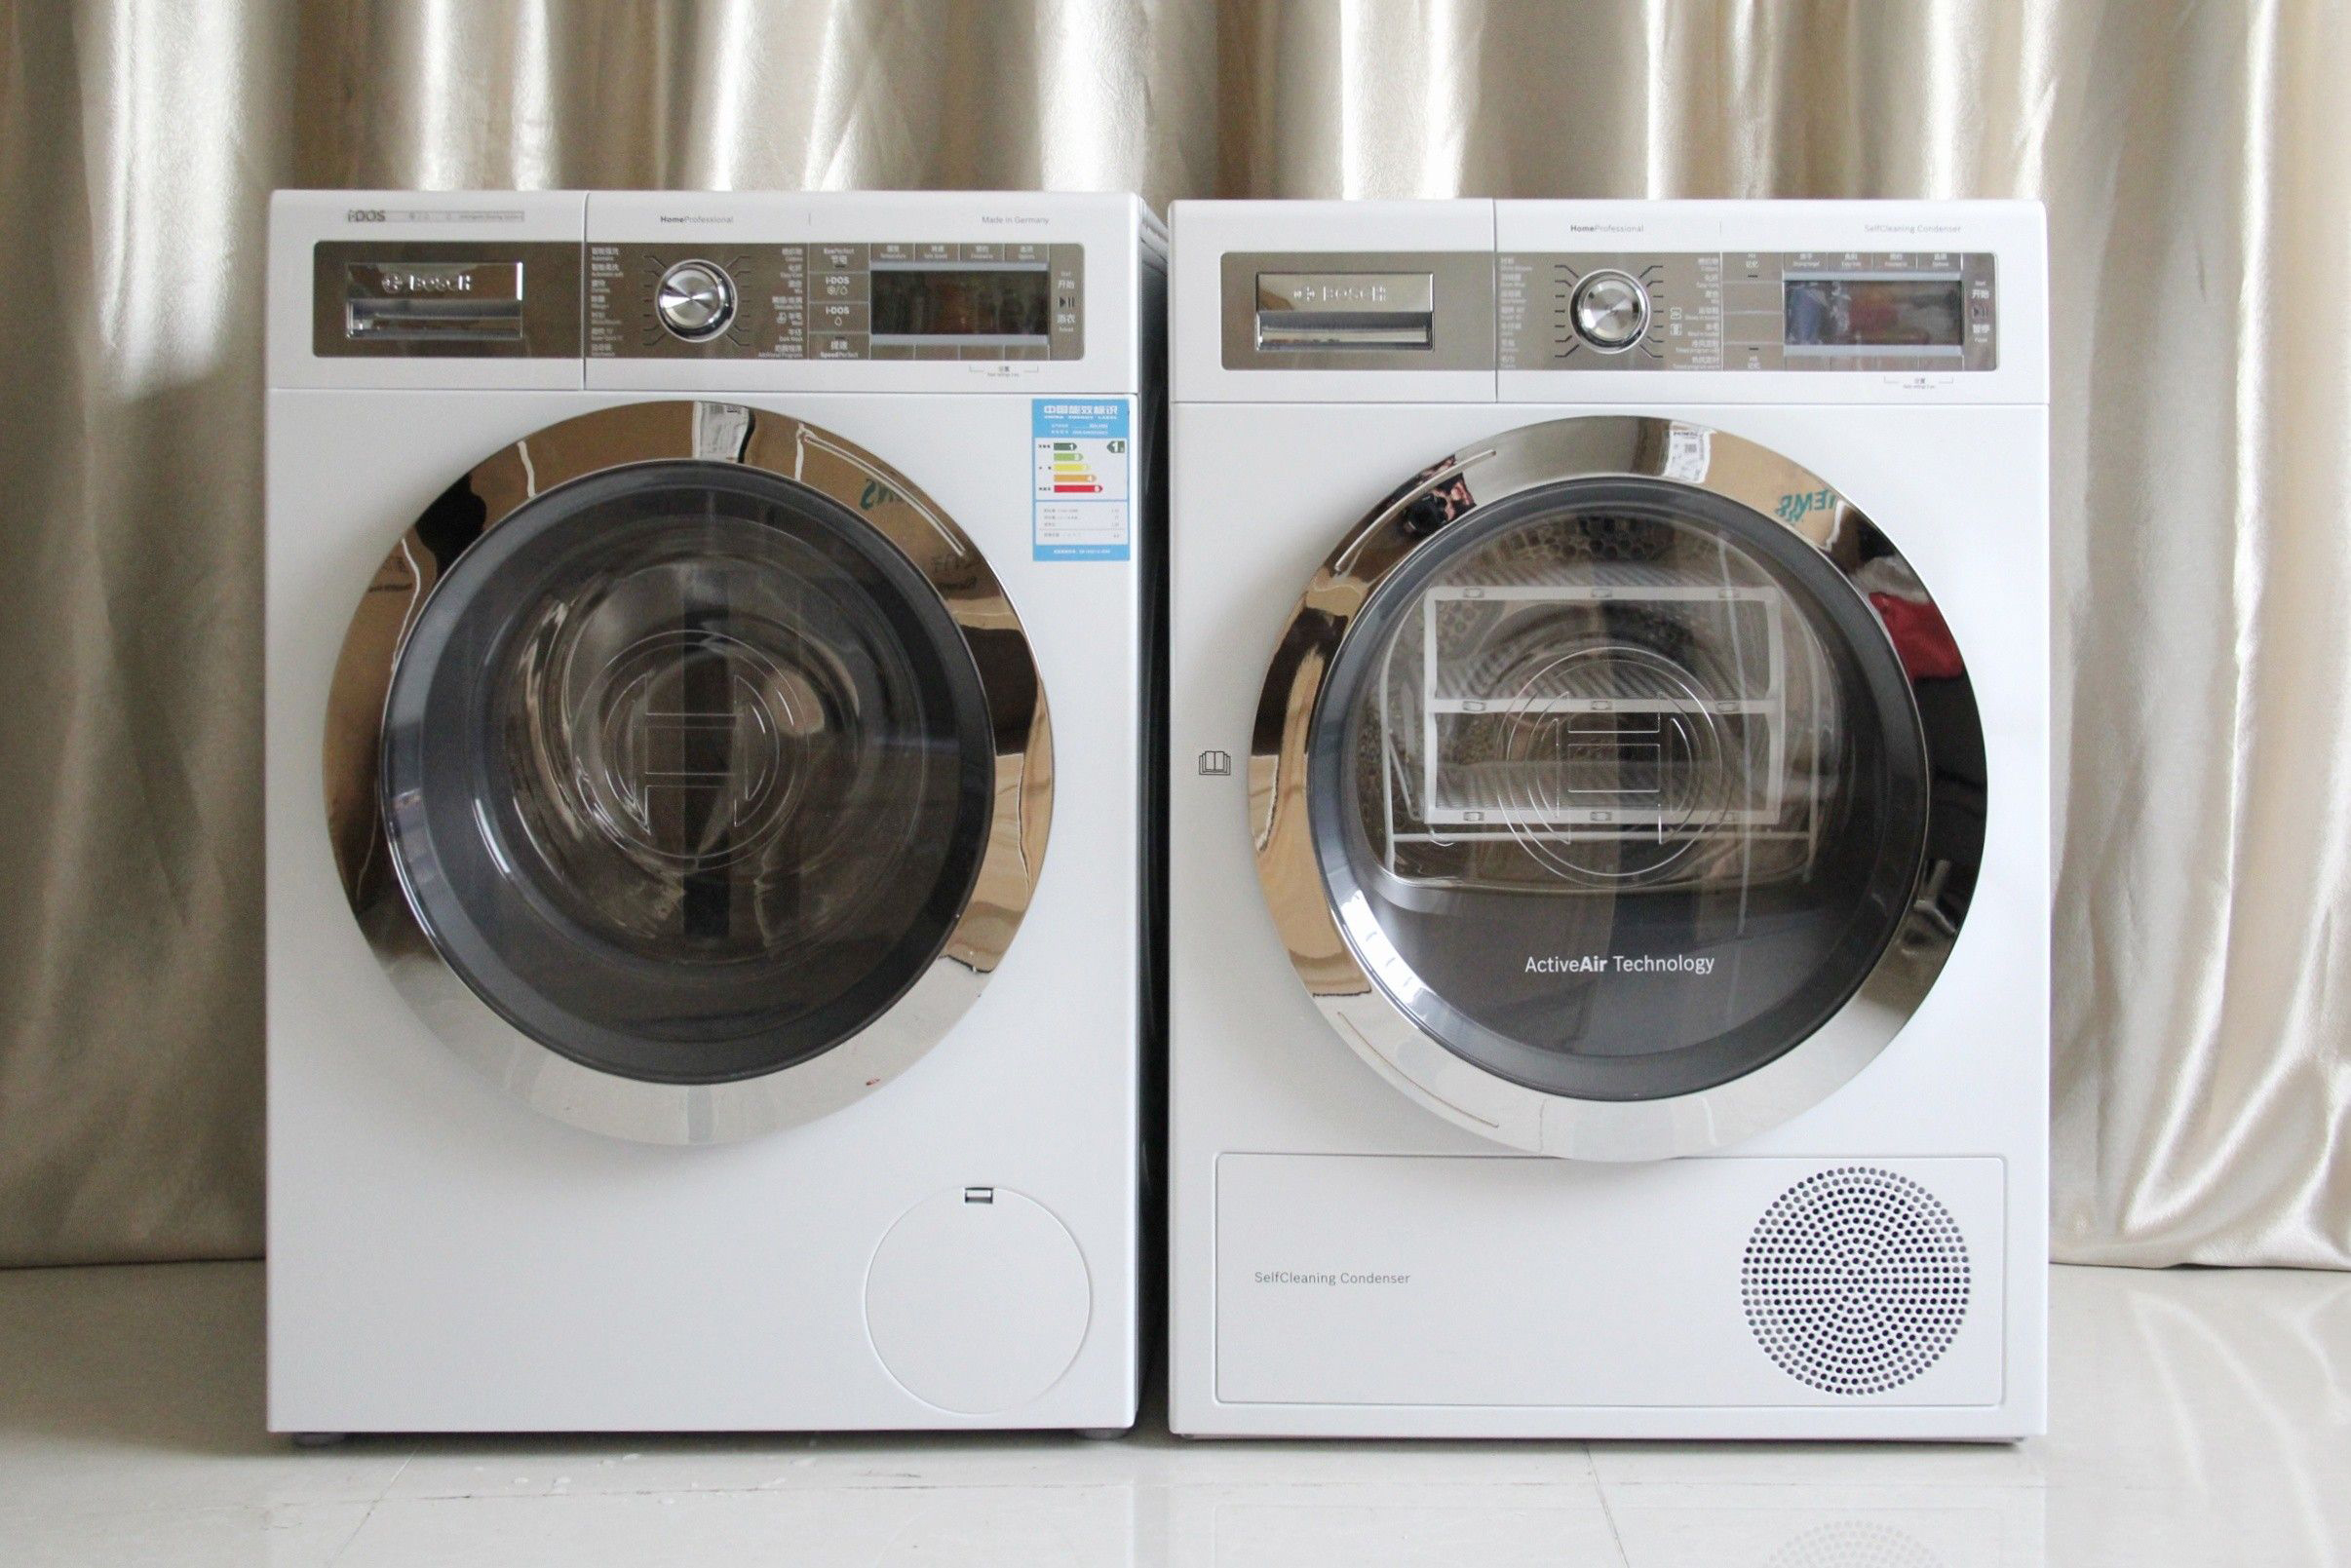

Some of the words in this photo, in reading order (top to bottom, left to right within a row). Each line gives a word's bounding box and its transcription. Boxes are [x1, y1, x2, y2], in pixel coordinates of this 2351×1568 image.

[660, 215, 734, 224] HomeProfessional
[1014, 216, 1049, 225] Germany
[1570, 224, 1644, 233] HomeProfessional
[1864, 224, 1915, 234] SelfCleaning
[1917, 224, 1961, 233] Condenser
[1524, 956, 1608, 973] ActiveAir
[1613, 954, 1715, 975] Technology
[1253, 1271, 1336, 1286] SelfCleaning
[1340, 1271, 1410, 1284] Condenser
